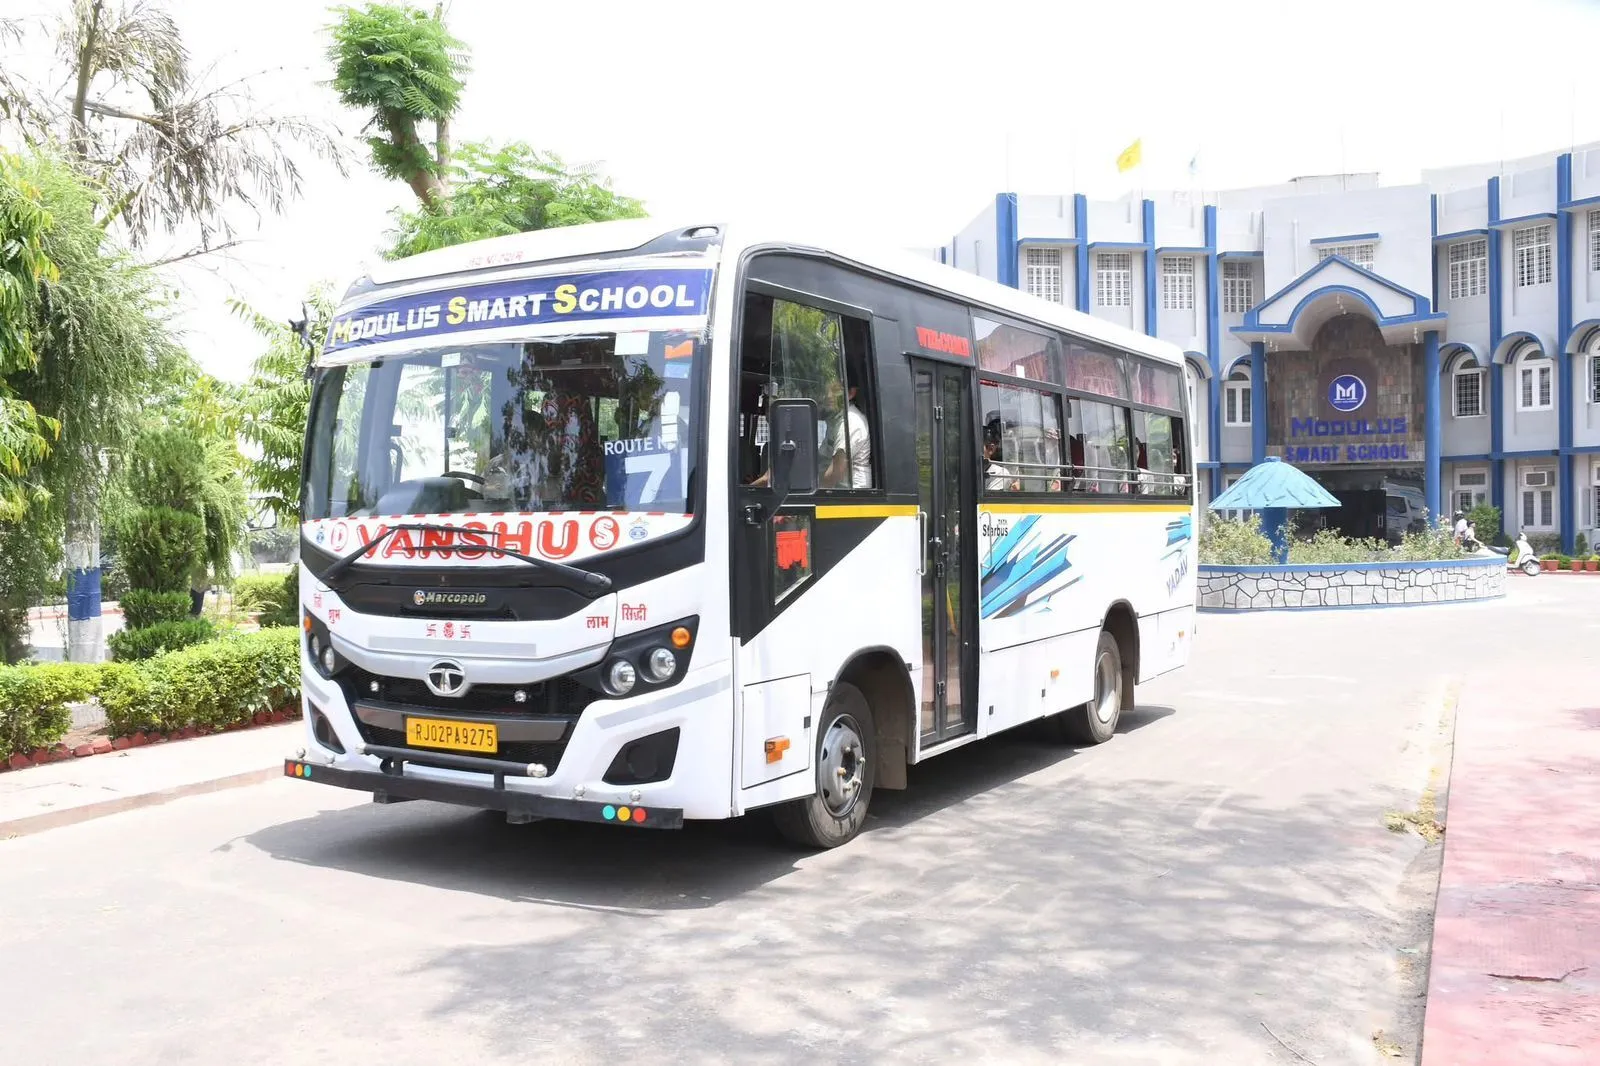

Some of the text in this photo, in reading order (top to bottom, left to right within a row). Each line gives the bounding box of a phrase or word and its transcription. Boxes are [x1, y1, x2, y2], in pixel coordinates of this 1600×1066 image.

[330, 283, 695, 347] MODULUS SMART SCHOOL
[603, 436, 654, 456] ROUTE
[1286, 443, 1408, 462] SMART SCHOOL
[624, 452, 672, 504] 7
[356, 519, 579, 560] VANSHU
[982, 523, 1008, 537] Starbus
[1166, 554, 1188, 596] YADAV
[426, 591, 487, 605] Marcopolo
[586, 616, 609, 629] लाभ
[415, 723, 494, 747] RJ02PA9275
